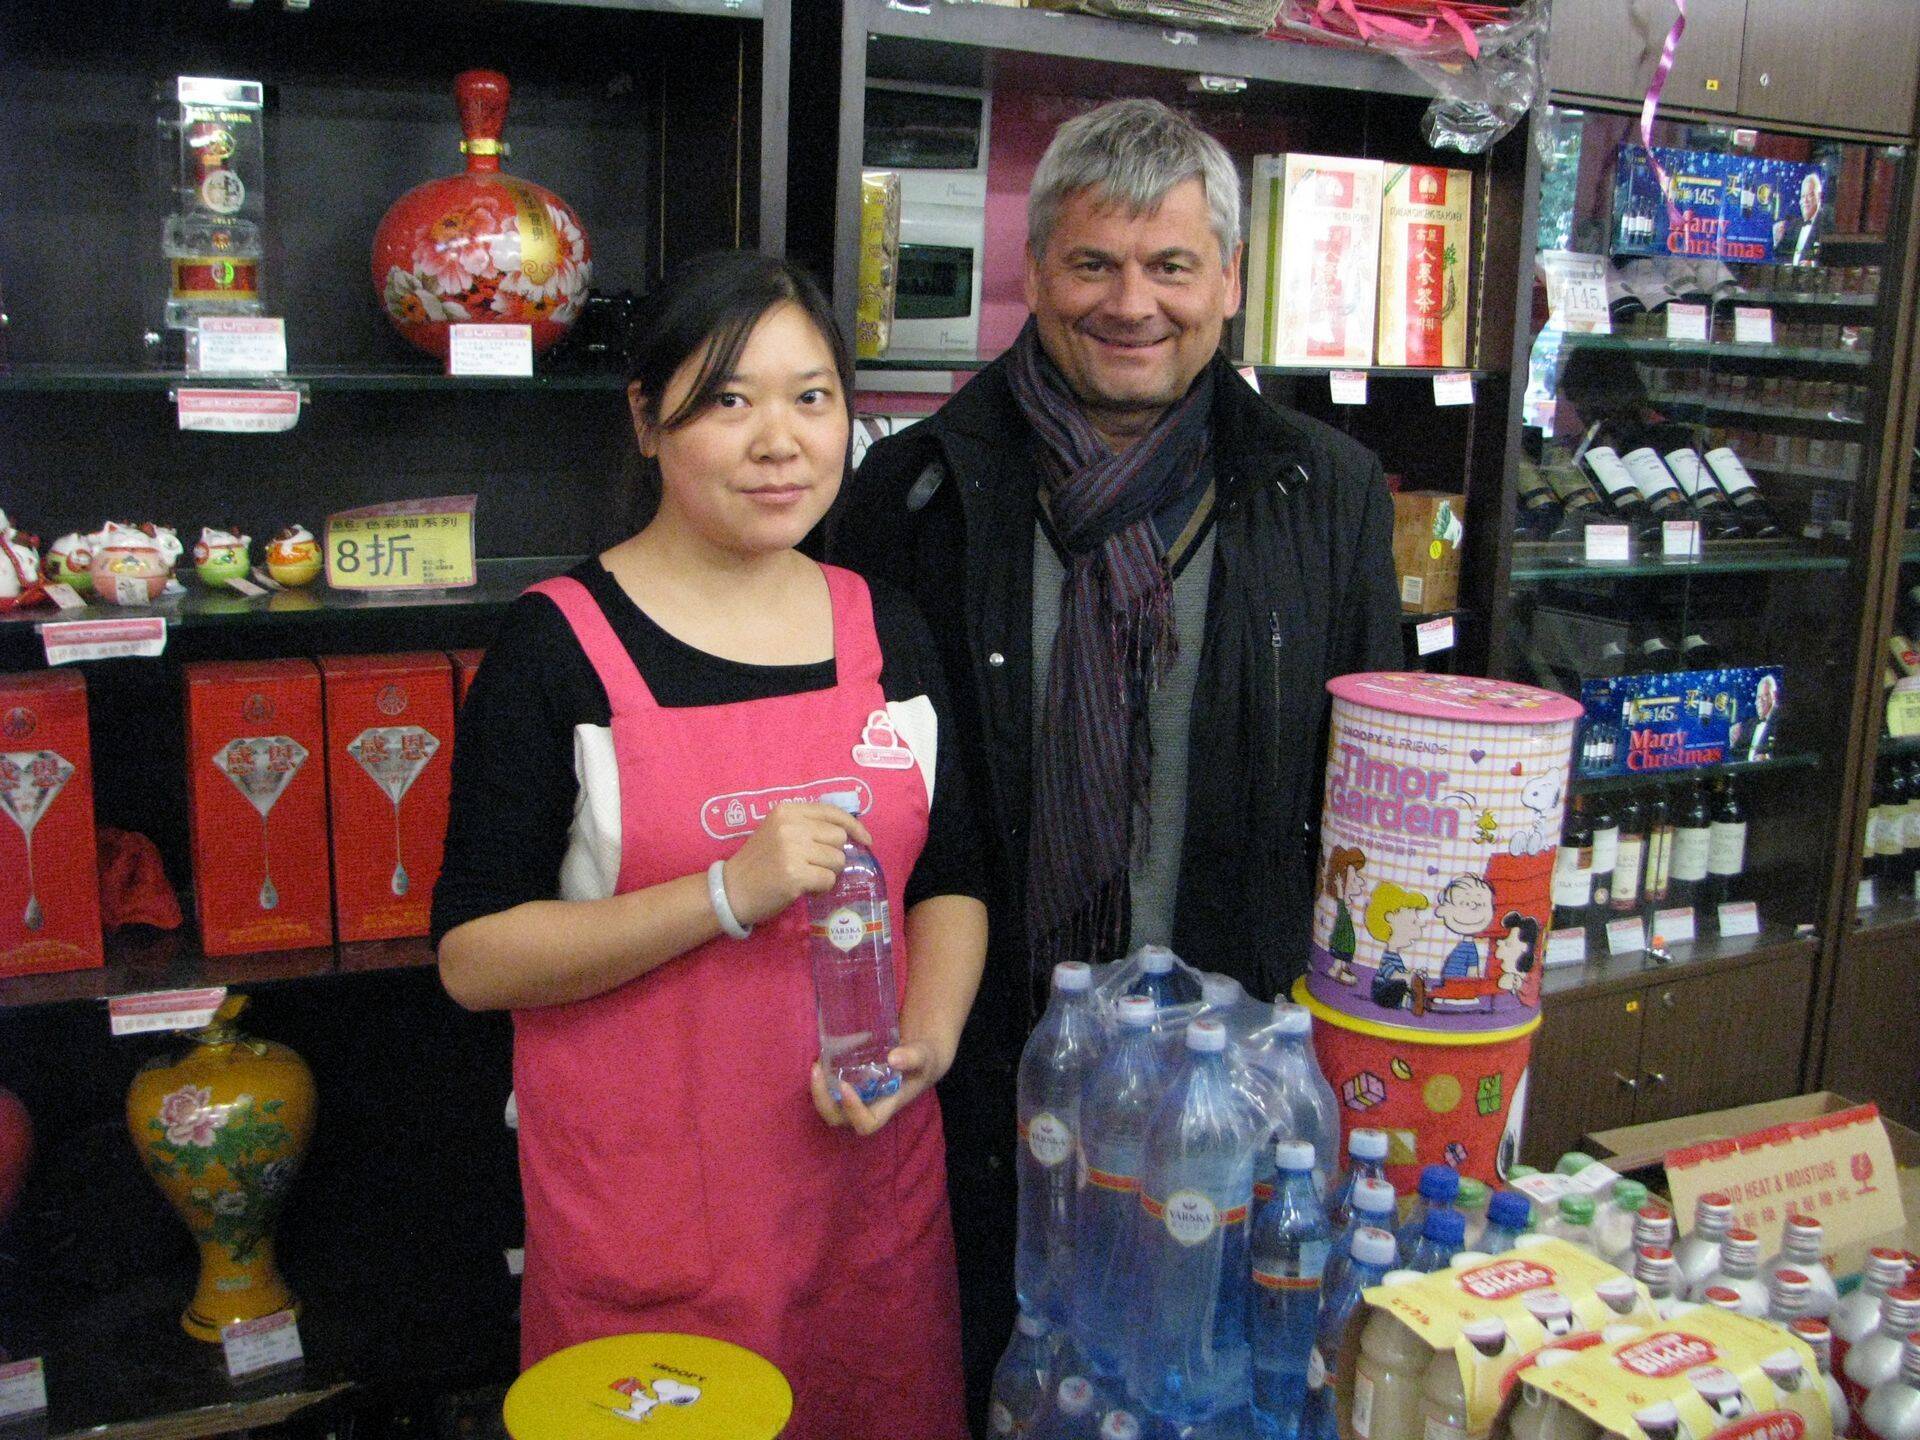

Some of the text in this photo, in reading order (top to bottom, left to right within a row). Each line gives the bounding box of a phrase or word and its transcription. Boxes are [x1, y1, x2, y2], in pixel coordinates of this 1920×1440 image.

[1693, 187, 1715, 206] 145
[1667, 230, 1765, 259] Christmas
[337, 533, 415, 577] 8折
[1654, 705, 1676, 721] 145
[1400, 738, 1448, 755] FRIENDS
[1627, 748, 1721, 770] Christmas
[1340, 741, 1449, 801] Timor
[1331, 774, 1460, 839] Garden
[1744, 1177, 1772, 1200] HEAT
[1785, 1160, 1838, 1189] MOISTURE
